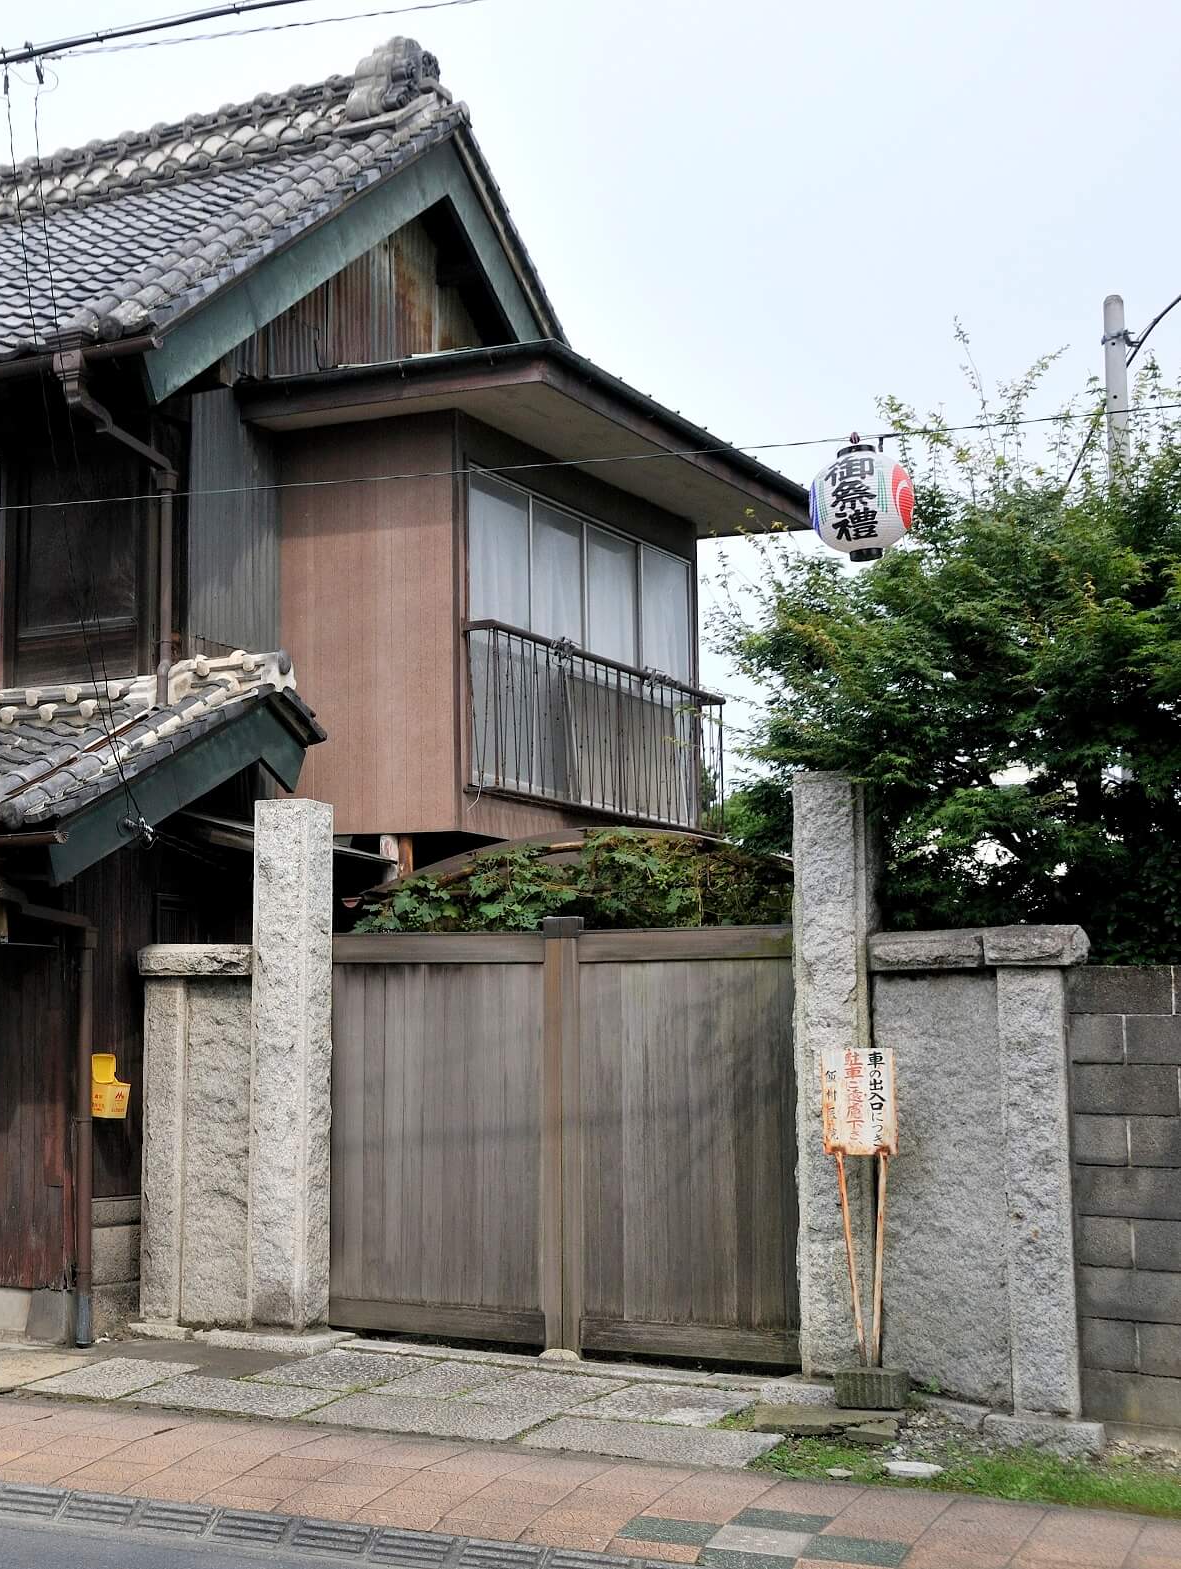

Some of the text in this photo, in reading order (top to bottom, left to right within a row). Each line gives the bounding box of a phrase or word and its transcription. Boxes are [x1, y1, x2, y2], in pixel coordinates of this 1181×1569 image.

[867, 1051, 885, 1147] 車の出入口につき
